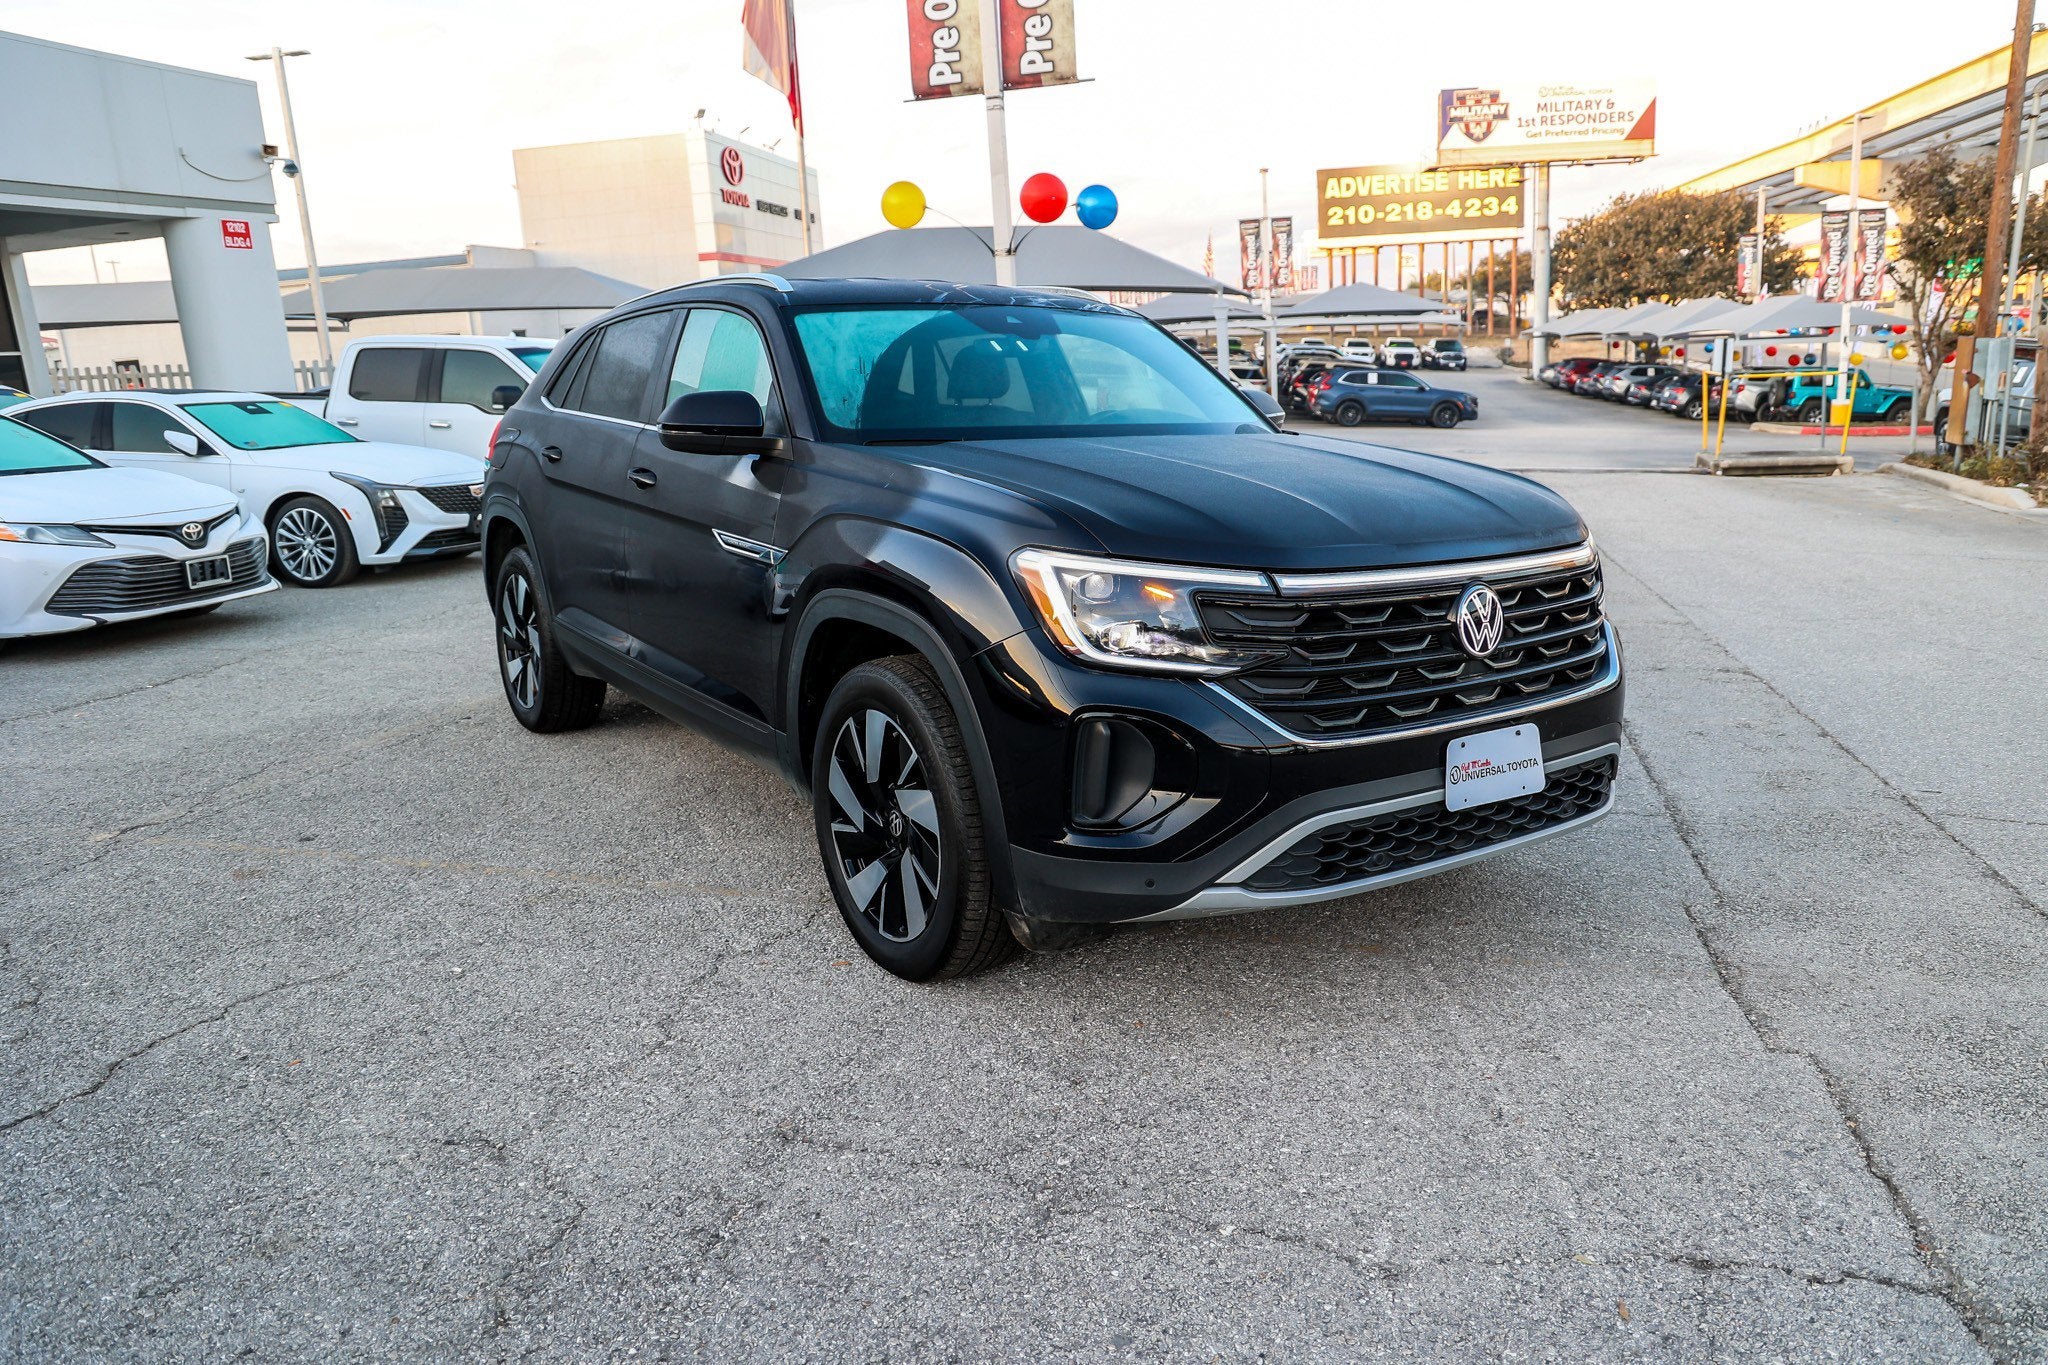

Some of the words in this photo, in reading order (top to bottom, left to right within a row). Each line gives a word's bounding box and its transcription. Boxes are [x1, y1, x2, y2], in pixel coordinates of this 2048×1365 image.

[1019, 13, 1054, 76] Pre
[928, 26, 963, 87] Pre
[1449, 103, 1507, 118] MILITARY
[1537, 99, 1602, 113] MILITARY
[1517, 117, 1536, 128] 1st
[1540, 111, 1635, 127] RESPONDERS
[1526, 129, 1543, 139] Get
[1544, 127, 1590, 138] Preferred
[1591, 126, 1625, 137] Pricing
[1324, 170, 1449, 200] ADVERTISE
[1457, 167, 1521, 191] HERE
[720, 188, 750, 208] TOYOTA
[1327, 196, 1519, 226] 210-218-4234
[1826, 231, 1842, 275] Owned
[1862, 229, 1878, 273] Owned
[1824, 277, 1839, 297] Pre
[1860, 275, 1875, 296] Pre
[1462, 766, 1506, 781] UNIVERSAL
[1507, 757, 1539, 772] TOYOTA
